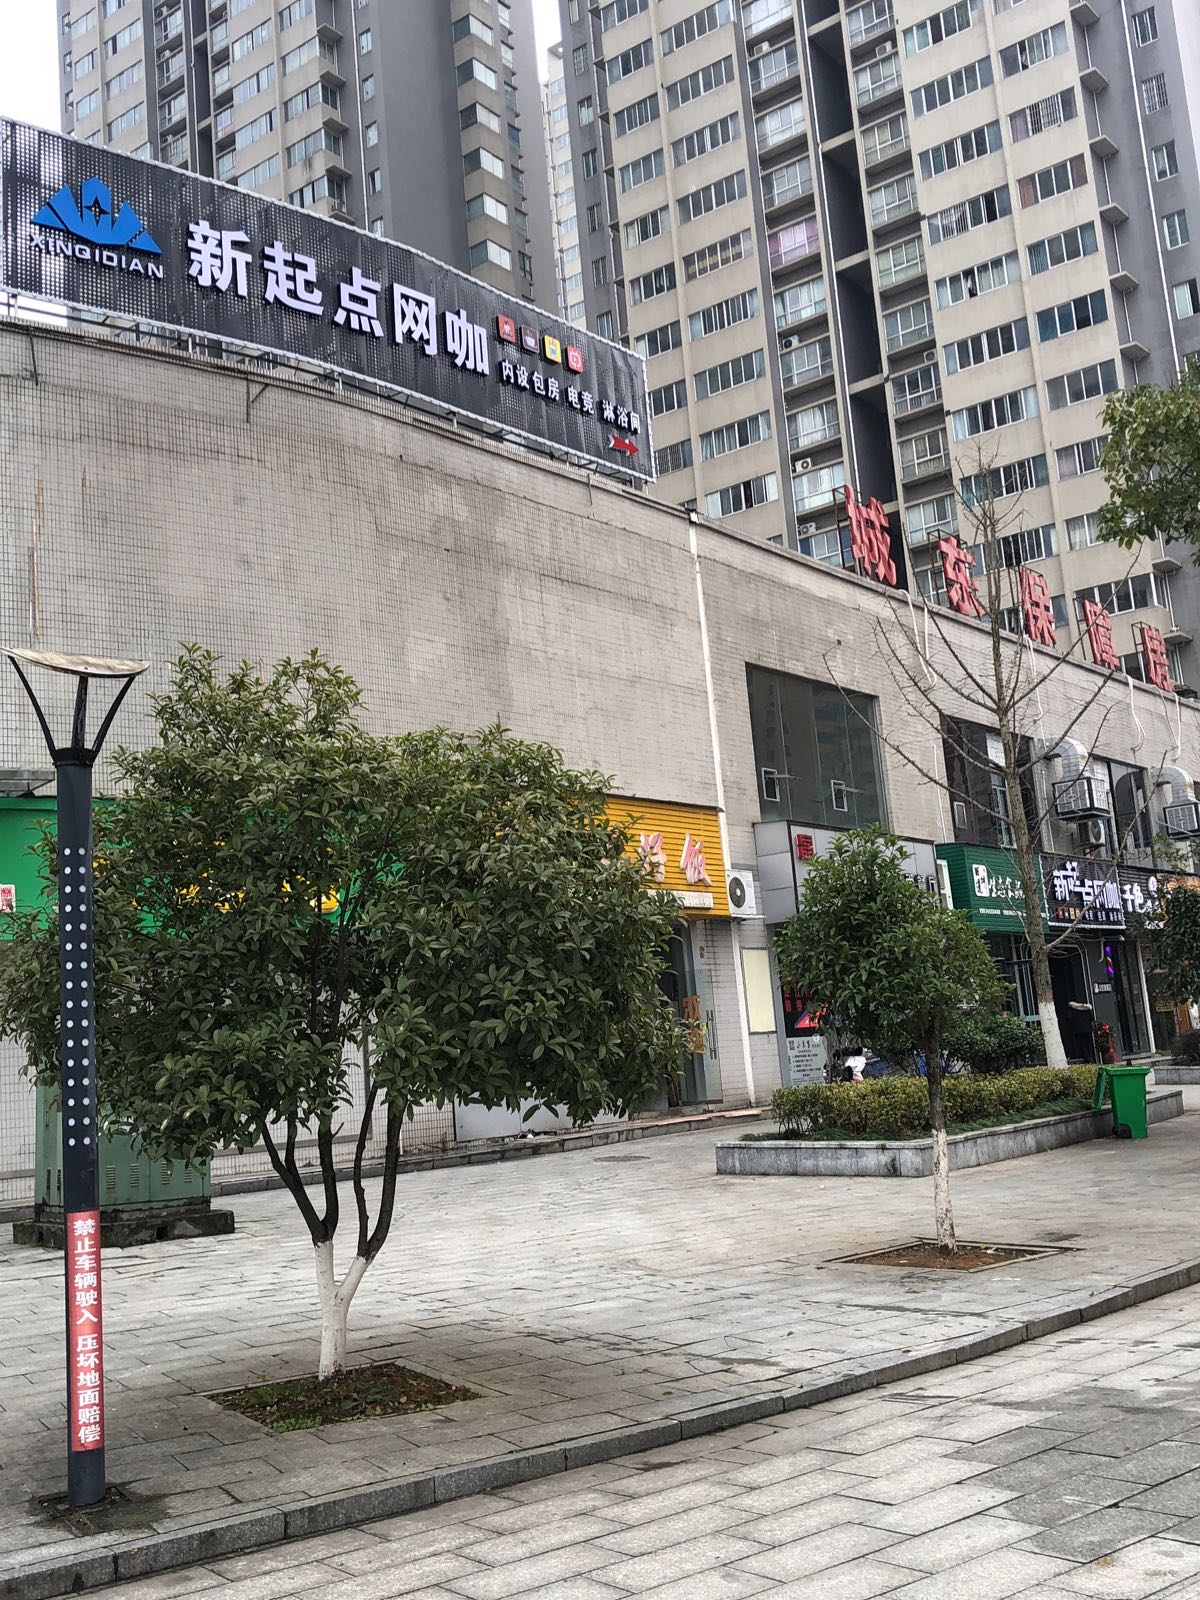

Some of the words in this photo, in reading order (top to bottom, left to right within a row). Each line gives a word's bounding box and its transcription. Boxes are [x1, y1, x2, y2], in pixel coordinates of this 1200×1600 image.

[30, 234, 164, 279] XINQIDIAN
[187, 220, 490, 376] 新起点网咖
[501, 358, 560, 401] 内设包房
[567, 385, 595, 415] 电竞
[602, 399, 641, 434] 淋浴间
[74, 1219, 99, 1325] 禁止车辆驶入
[76, 1333, 101, 1444] 压坏地面赔偿
